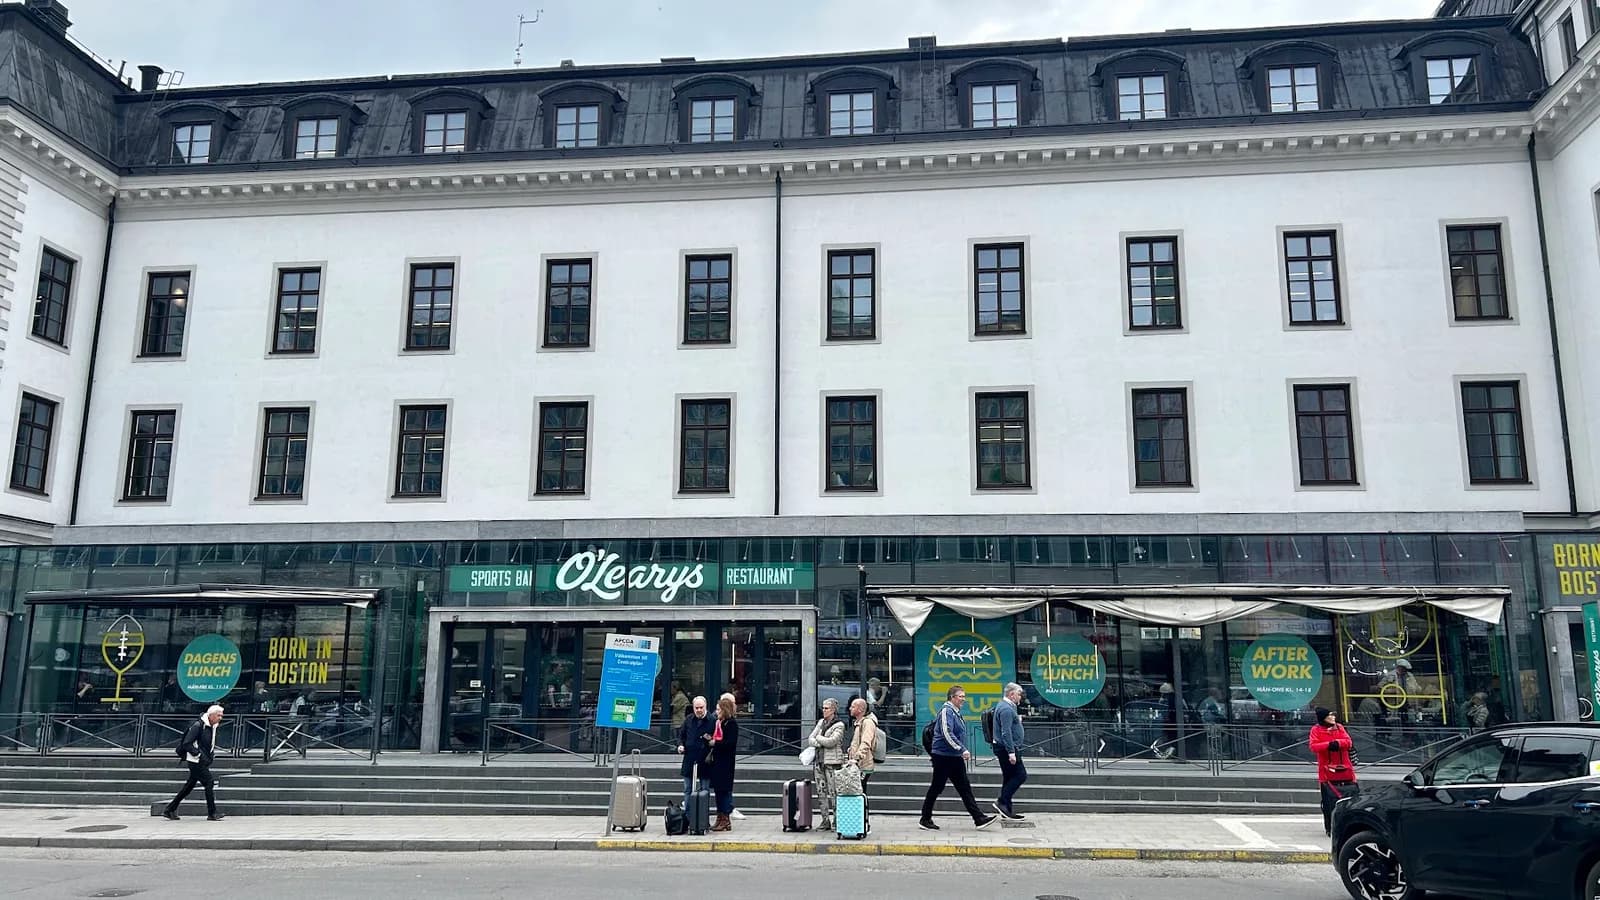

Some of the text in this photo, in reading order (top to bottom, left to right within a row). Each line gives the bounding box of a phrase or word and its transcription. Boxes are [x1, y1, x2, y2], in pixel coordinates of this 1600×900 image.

[1553, 544, 1600, 567] BORN
[471, 570, 512, 586] SPORTS
[556, 548, 704, 602] O'Learys
[726, 568, 794, 584] RESTAURANT
[268, 638, 332, 659] BORN IN
[1252, 646, 1308, 661] AFTER
[184, 652, 236, 664] DAGENS
[1037, 654, 1098, 666] DAGENS
[187, 666, 231, 677] LUNCH
[268, 662, 328, 684] BOSTON
[1043, 668, 1094, 680] LUNCH
[1251, 664, 1312, 679] WORK
